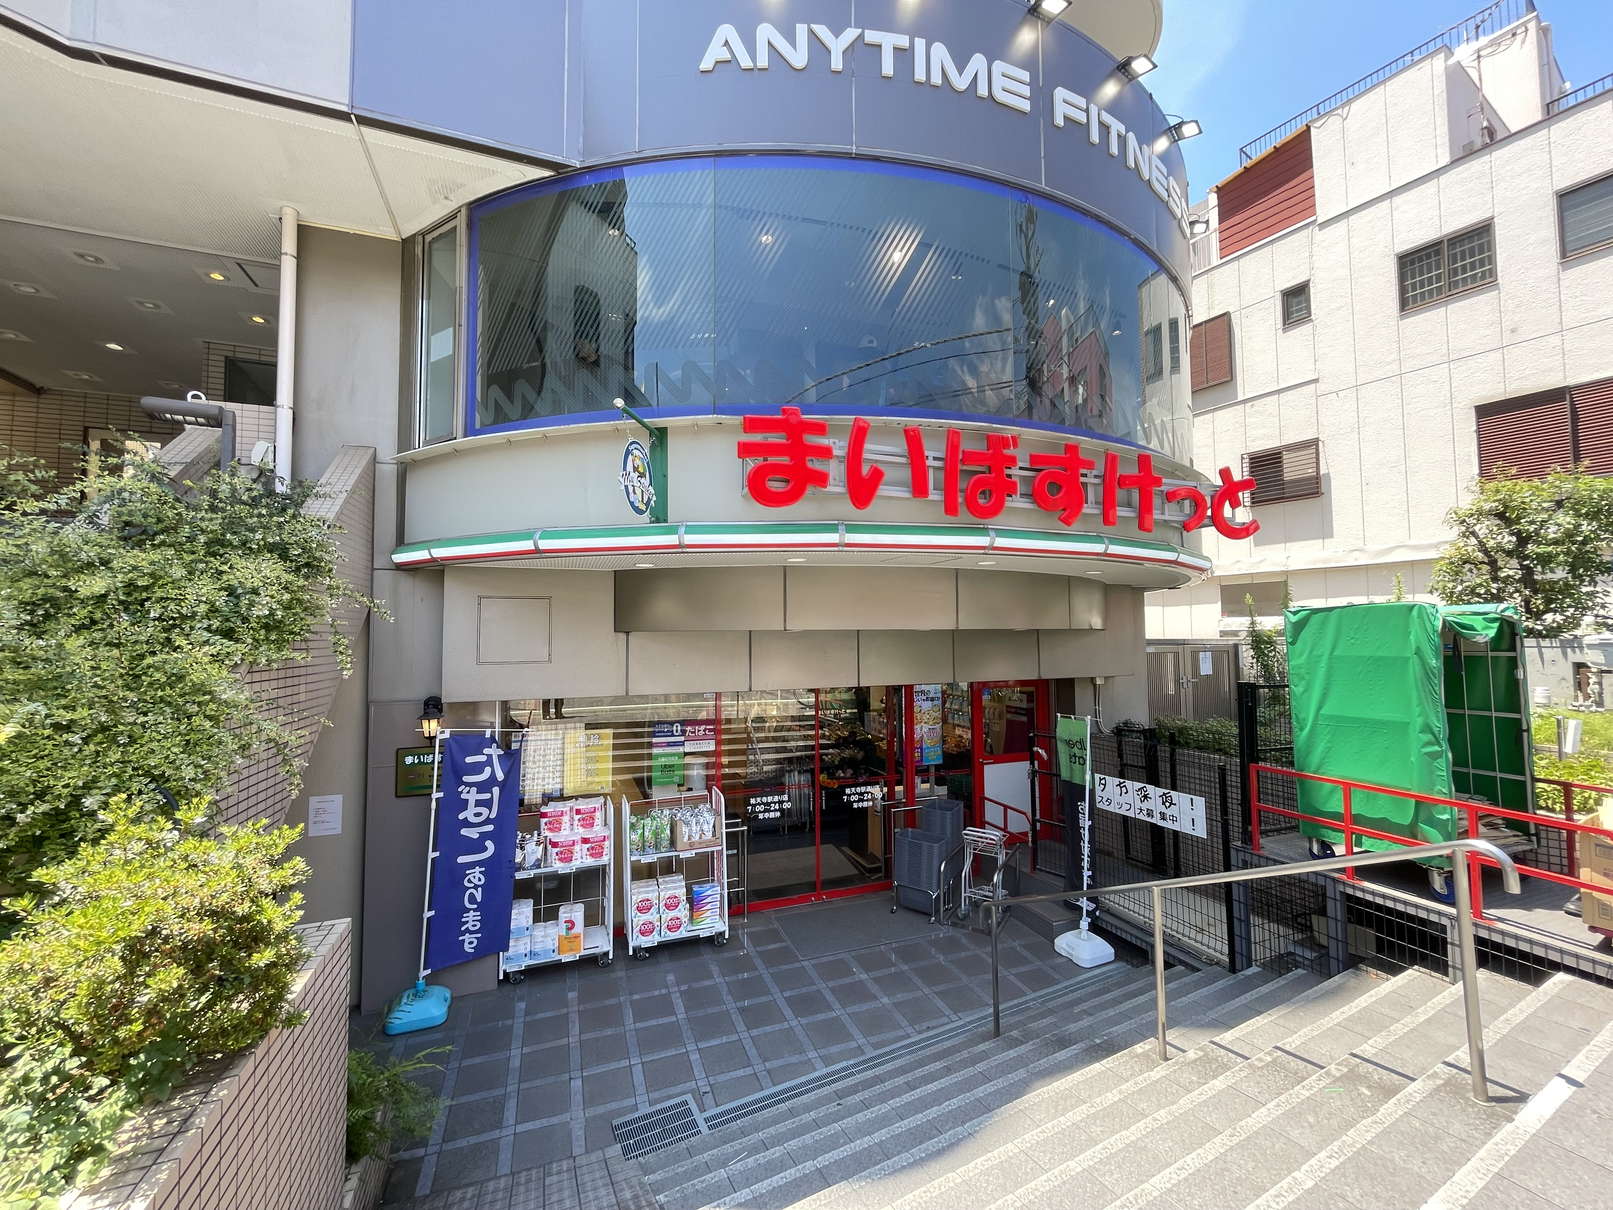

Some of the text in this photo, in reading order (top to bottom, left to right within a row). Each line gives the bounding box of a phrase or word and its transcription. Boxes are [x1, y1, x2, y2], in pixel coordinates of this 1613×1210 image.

[699, 23, 1031, 113] ANYTIME
[737, 405, 1260, 540] まいばすけっと
[685, 725, 714, 737] たばこ
